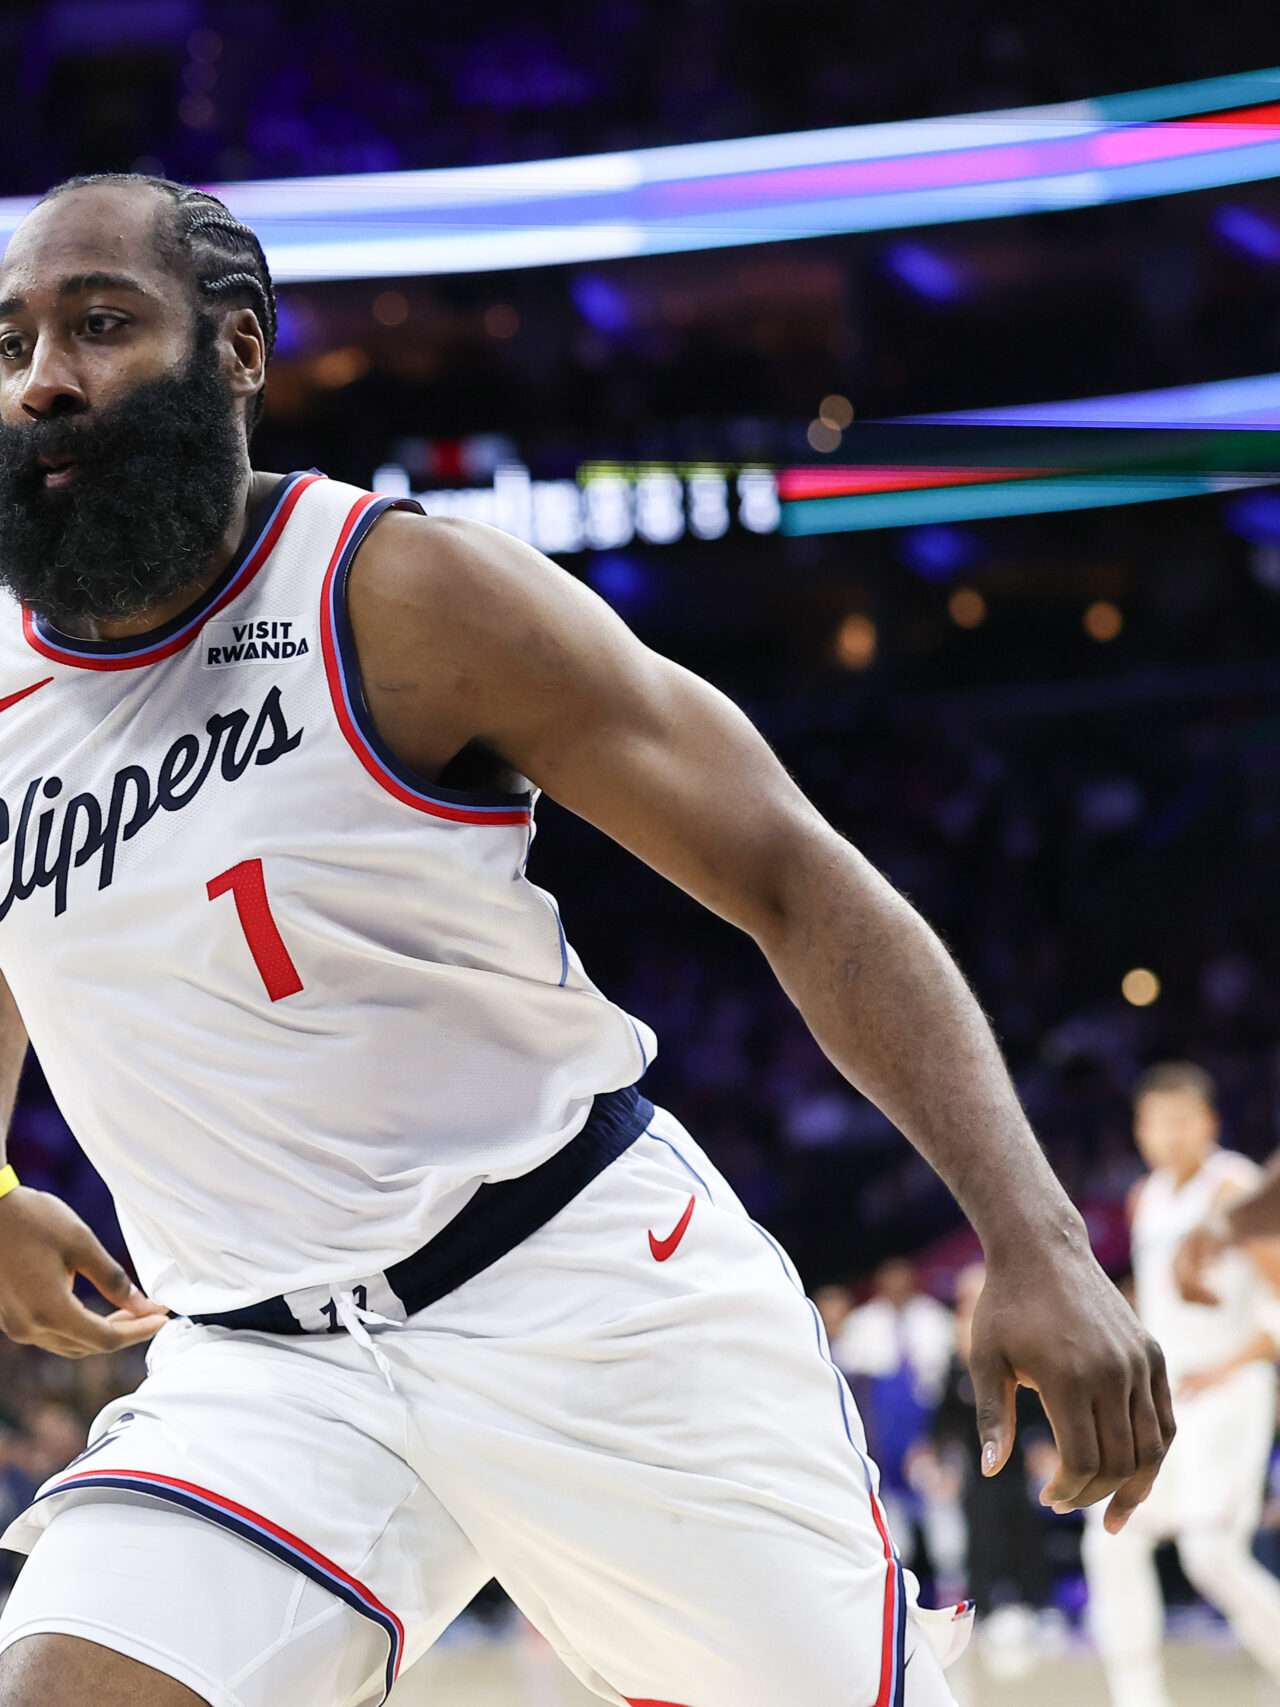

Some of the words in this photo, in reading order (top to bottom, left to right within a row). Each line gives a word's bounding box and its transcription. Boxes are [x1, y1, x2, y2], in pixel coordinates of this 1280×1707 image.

[232, 621, 292, 642] VISIT
[207, 637, 309, 665] RWANDA
[206, 858, 304, 1002] 1
